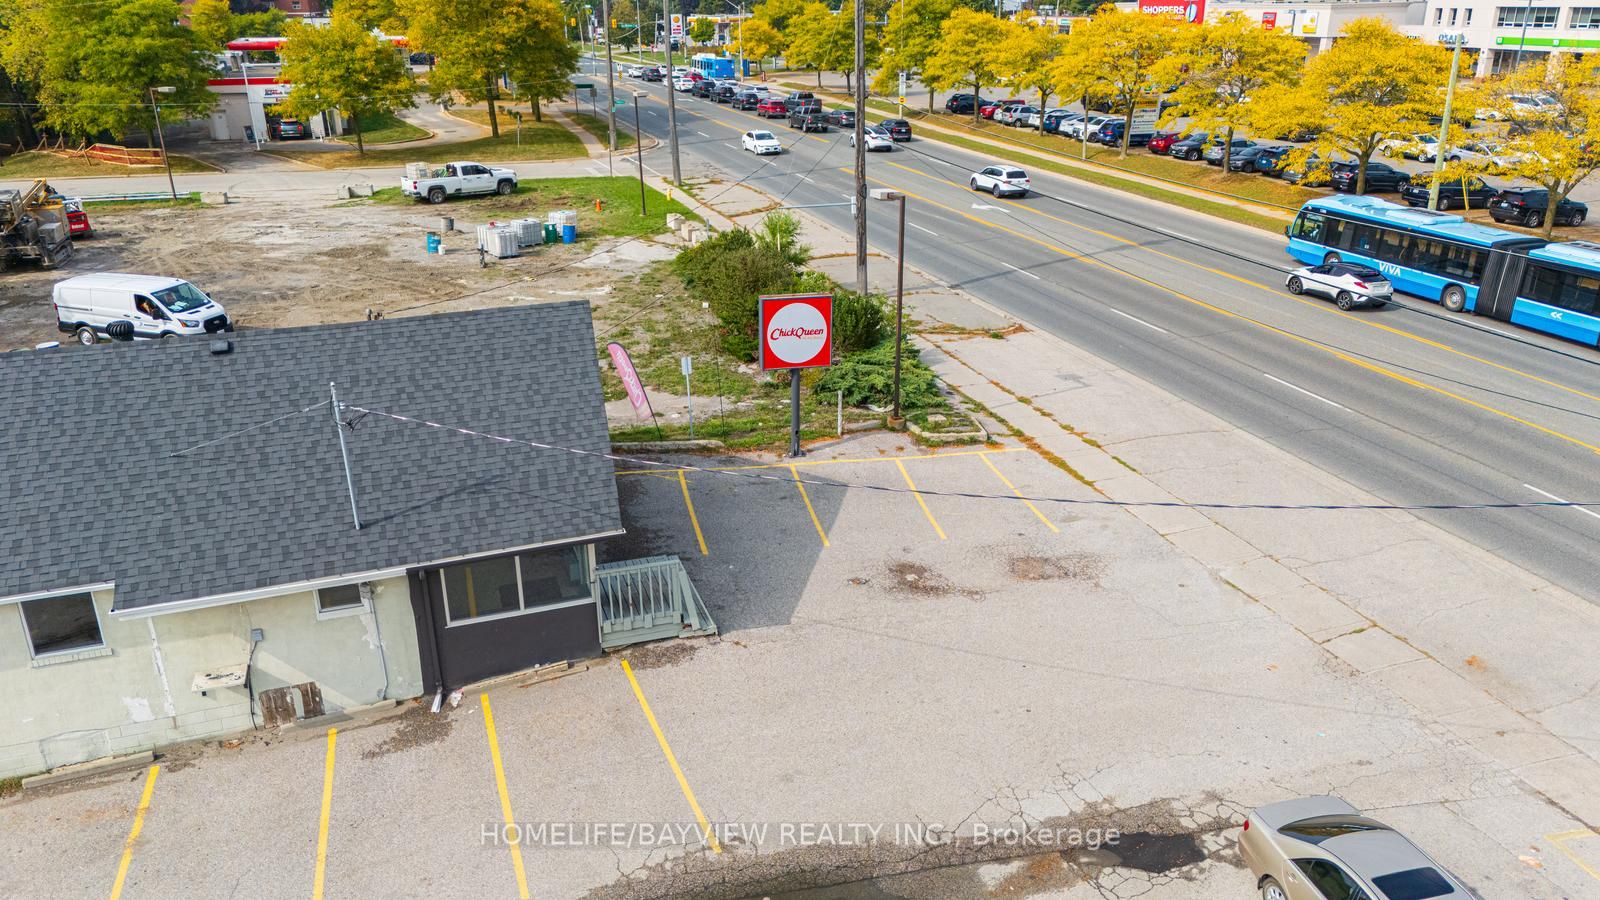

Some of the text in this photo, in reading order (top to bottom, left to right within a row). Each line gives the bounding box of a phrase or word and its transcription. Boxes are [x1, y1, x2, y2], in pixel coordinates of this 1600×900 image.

[1142, 5, 1185, 14] SHOPPERS
[1379, 262, 1401, 277] VIVA
[770, 327, 824, 341] ChickQueen
